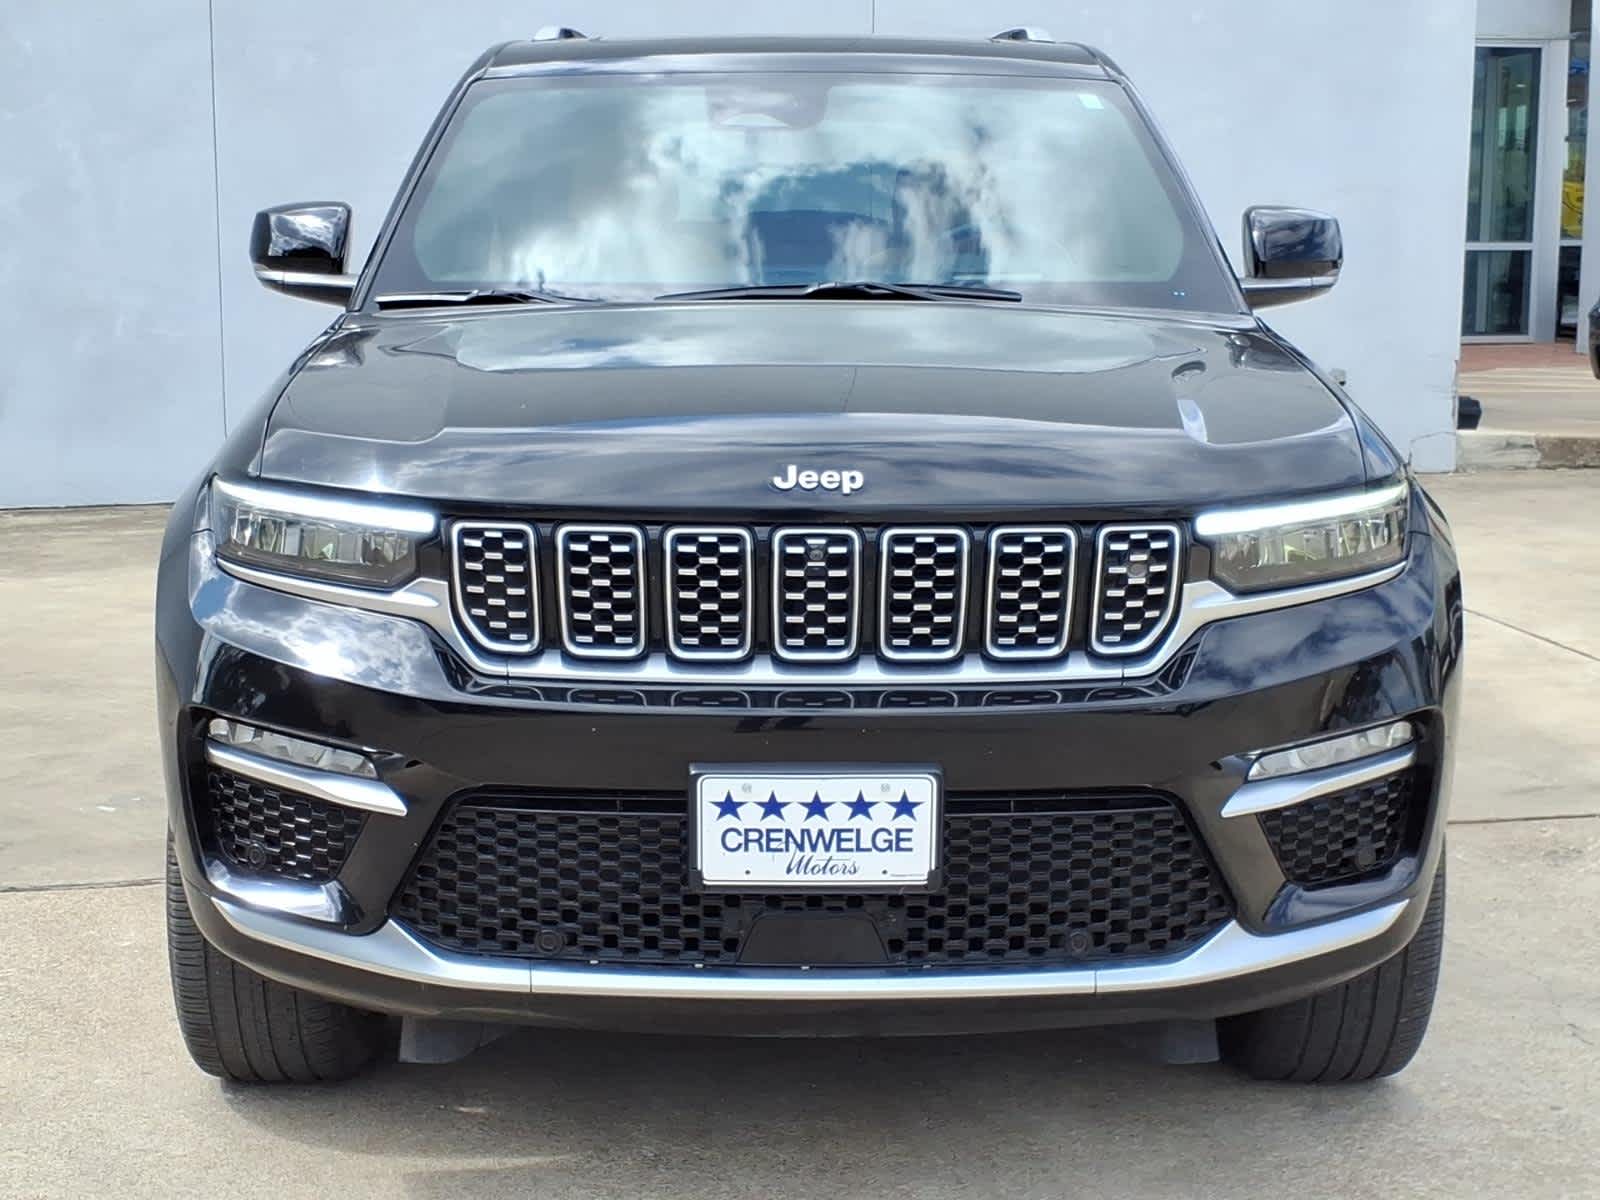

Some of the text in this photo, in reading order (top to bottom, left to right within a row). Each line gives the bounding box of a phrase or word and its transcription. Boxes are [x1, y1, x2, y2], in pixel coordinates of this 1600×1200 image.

[773, 464, 864, 495] Jeep
[720, 827, 914, 853] CRENWELGE
[785, 853, 860, 876] Motors
